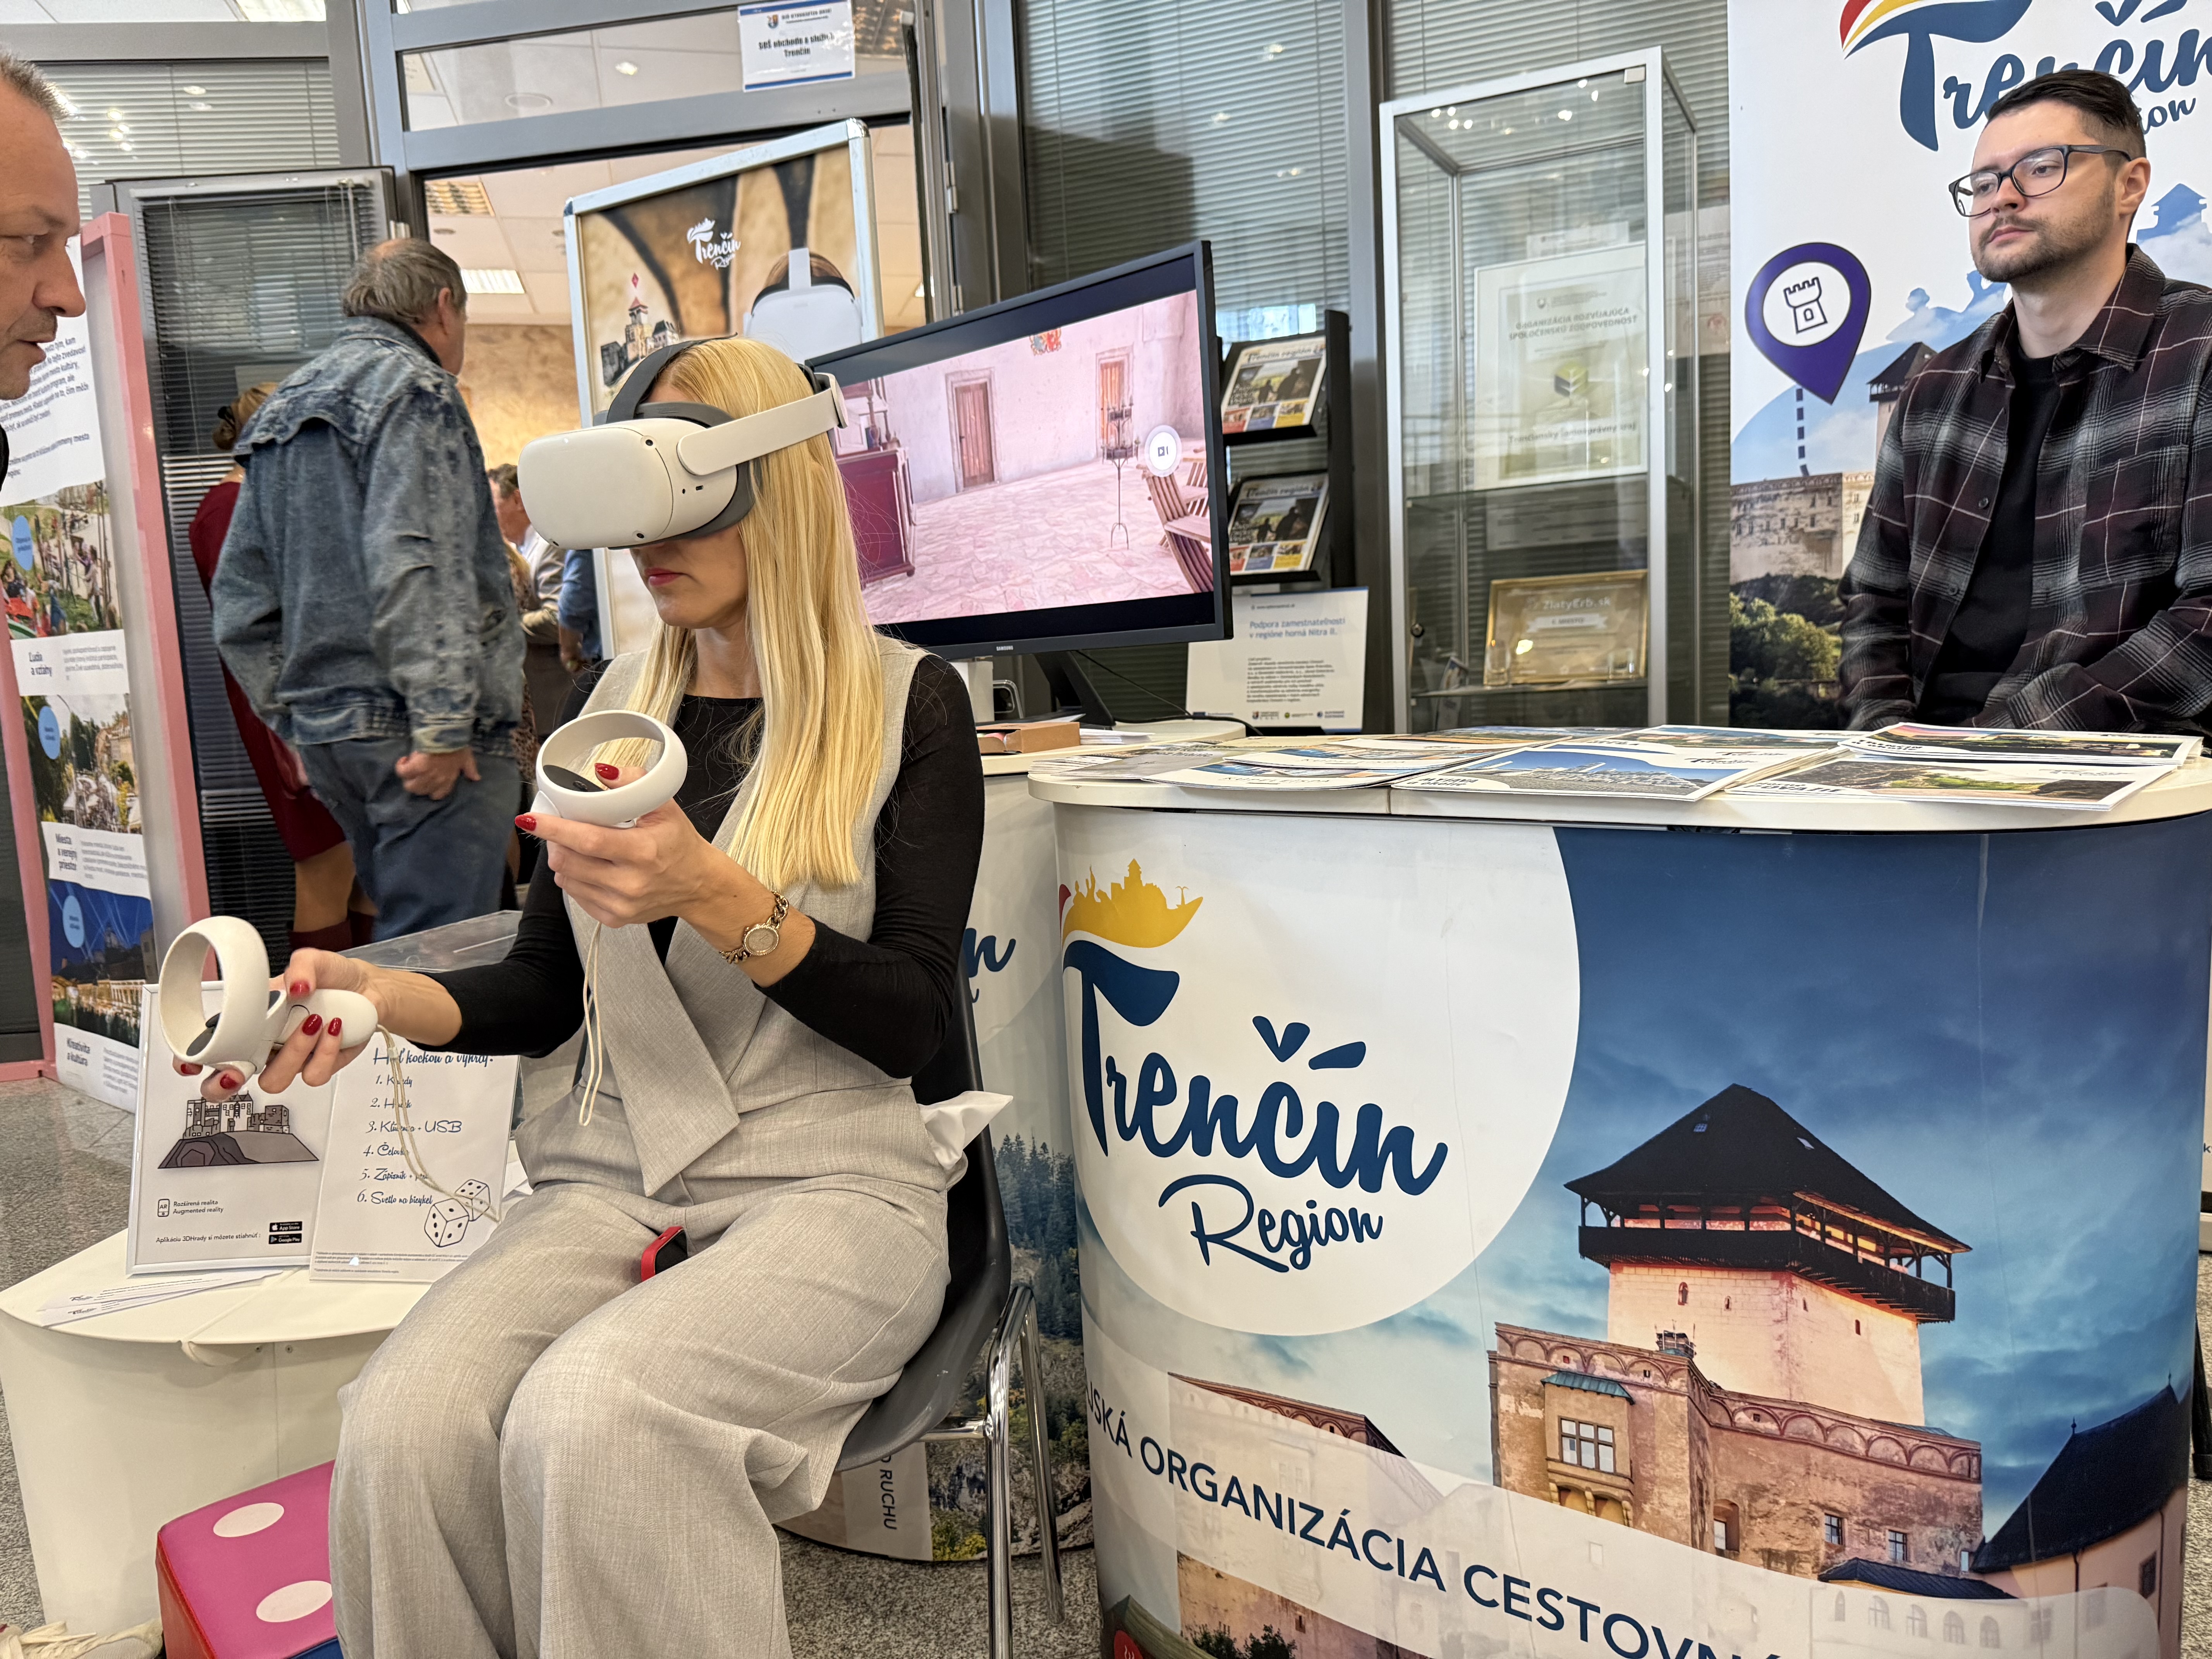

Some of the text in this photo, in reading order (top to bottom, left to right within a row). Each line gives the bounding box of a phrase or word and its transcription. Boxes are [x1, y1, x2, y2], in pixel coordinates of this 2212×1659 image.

[687, 231, 741, 264] Trenčín
[1250, 621, 1278, 629] Podpora
[406, 1050, 442, 1064] kockou
[445, 1055, 454, 1064] a
[1063, 940, 1448, 1195] Trenčín
[375, 1074, 383, 1084] 1.
[370, 1097, 380, 1108] 2.
[366, 1121, 377, 1133] 3.
[424, 1120, 462, 1133] USB
[363, 1144, 374, 1157] 4.
[359, 1168, 370, 1181] 5.
[374, 1168, 407, 1181] Zápisník
[357, 1189, 367, 1202] 6.
[371, 1191, 397, 1204] Svetlo
[409, 1195, 433, 1207] bicykel
[1159, 1174, 1383, 1273] Region
[879, 1469, 897, 1530] RUCHU
[1140, 1436, 1446, 1593] ORGANIZÁCIA
